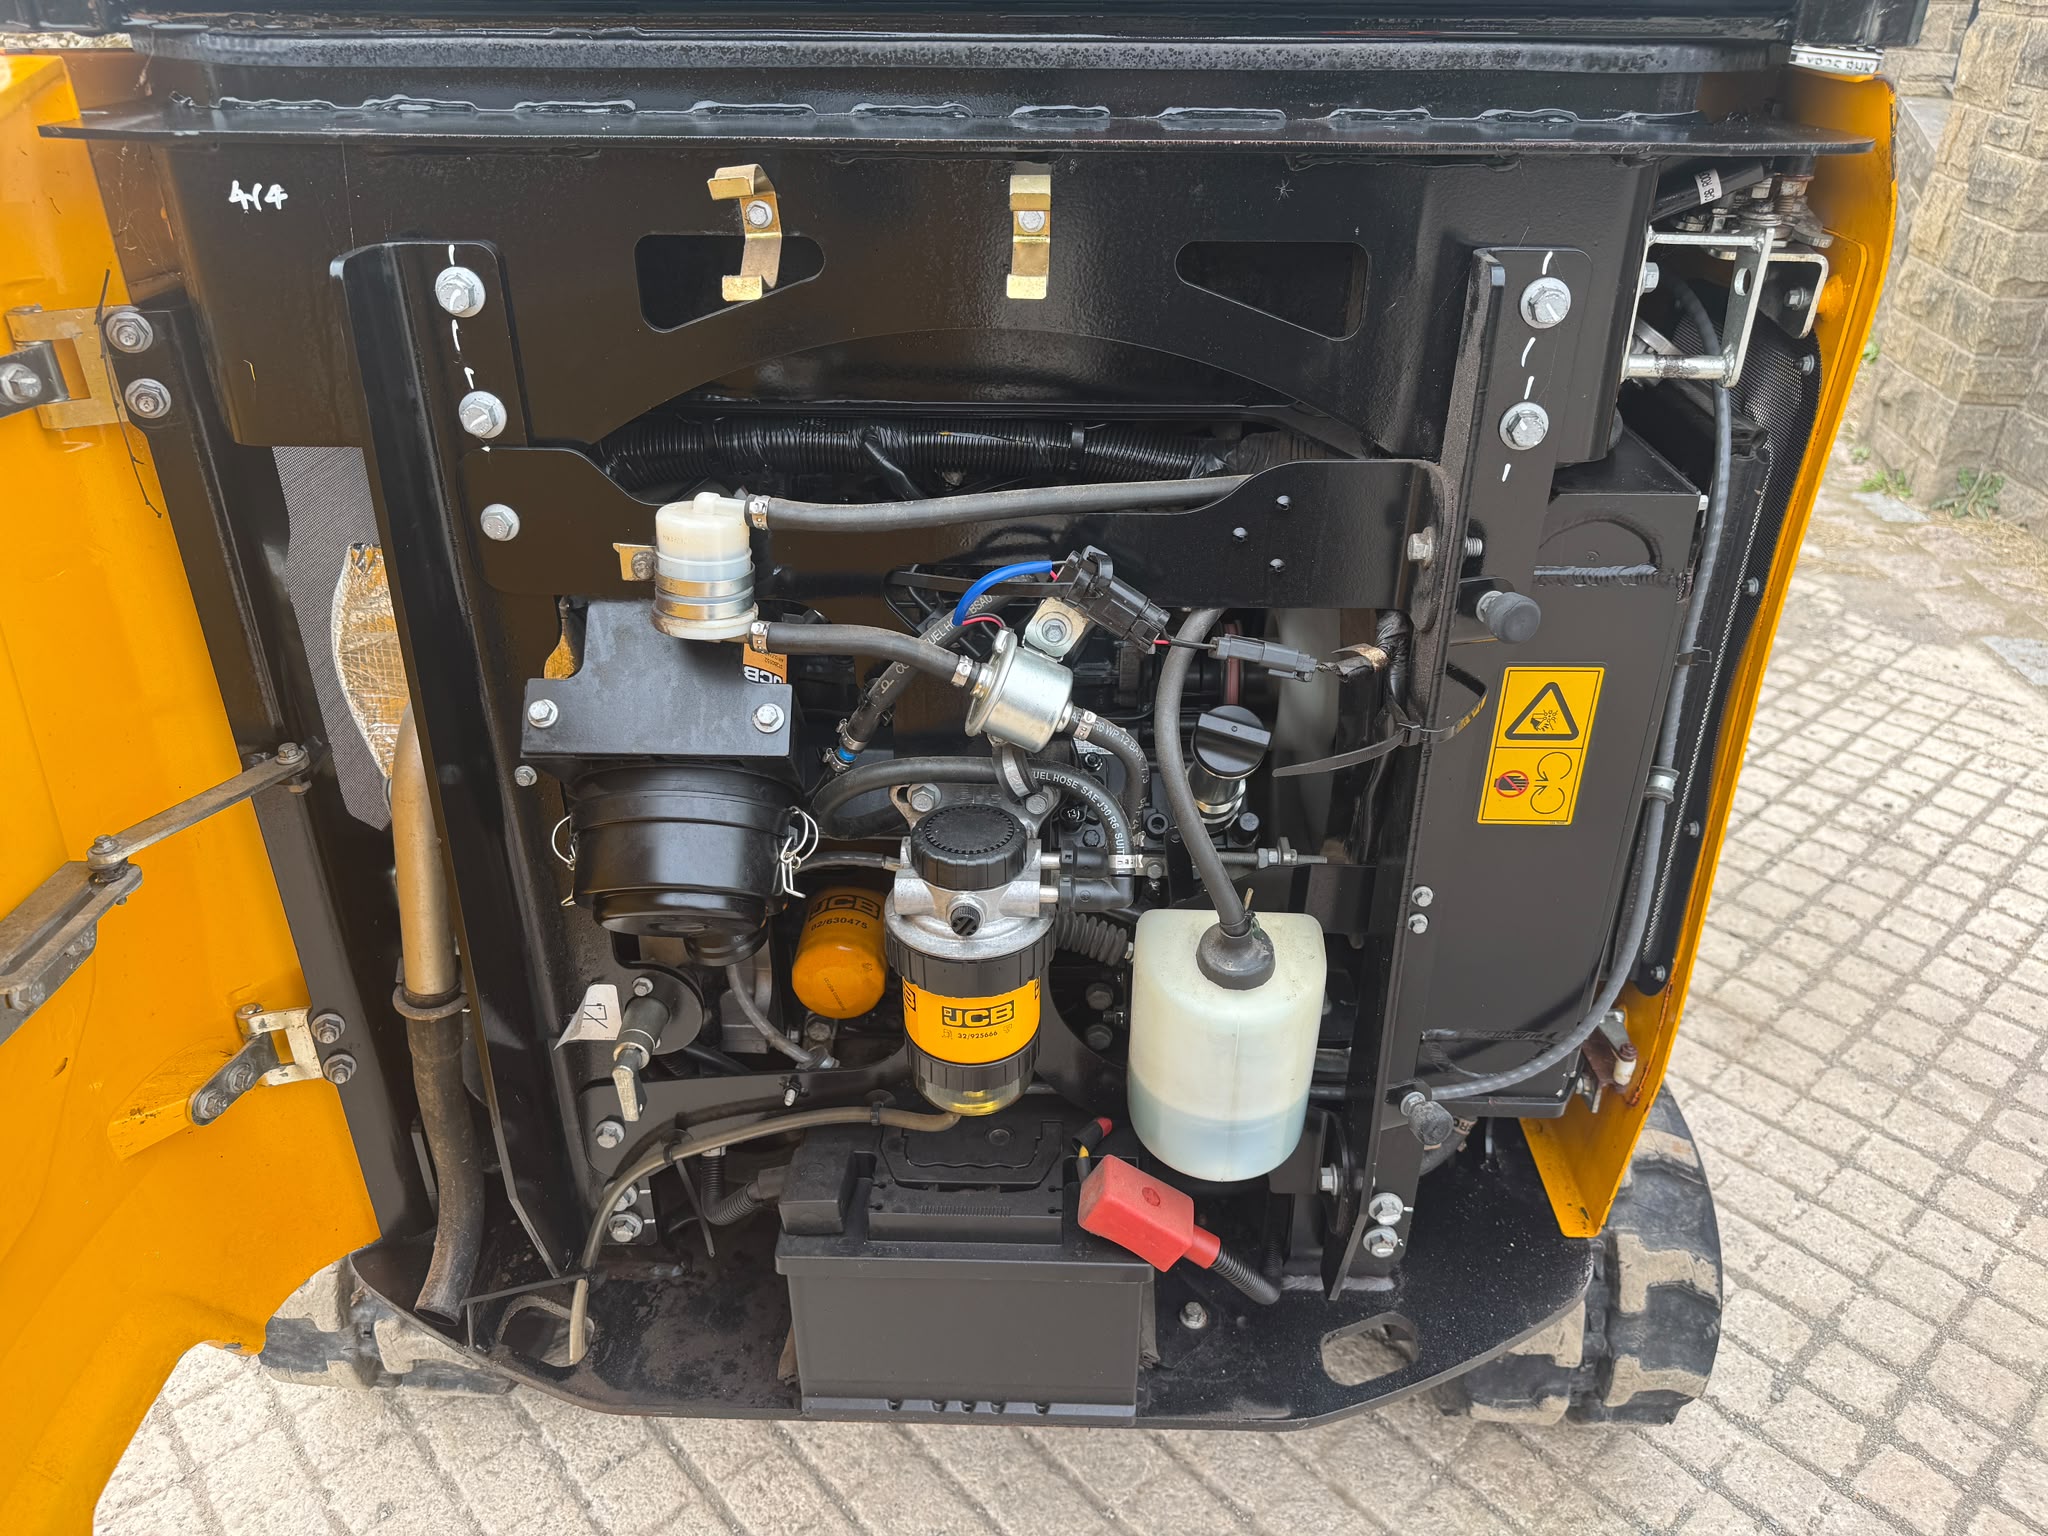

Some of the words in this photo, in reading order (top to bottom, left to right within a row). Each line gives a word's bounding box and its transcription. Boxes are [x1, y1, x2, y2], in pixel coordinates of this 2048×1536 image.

[1106, 724, 1120, 739] WP
[1119, 733, 1131, 747] 12
[1129, 739, 1144, 761] BAR
[1033, 770, 1052, 781] UEL
[1053, 773, 1079, 790] HOSE
[1080, 785, 1101, 804] SAE
[1096, 799, 1112, 818] J30
[1107, 815, 1120, 831] R6
[810, 895, 880, 920] JCB
[811, 917, 868, 932] 02/630475
[943, 1003, 1013, 1027] JCB
[957, 1031, 998, 1040] 32/925666
